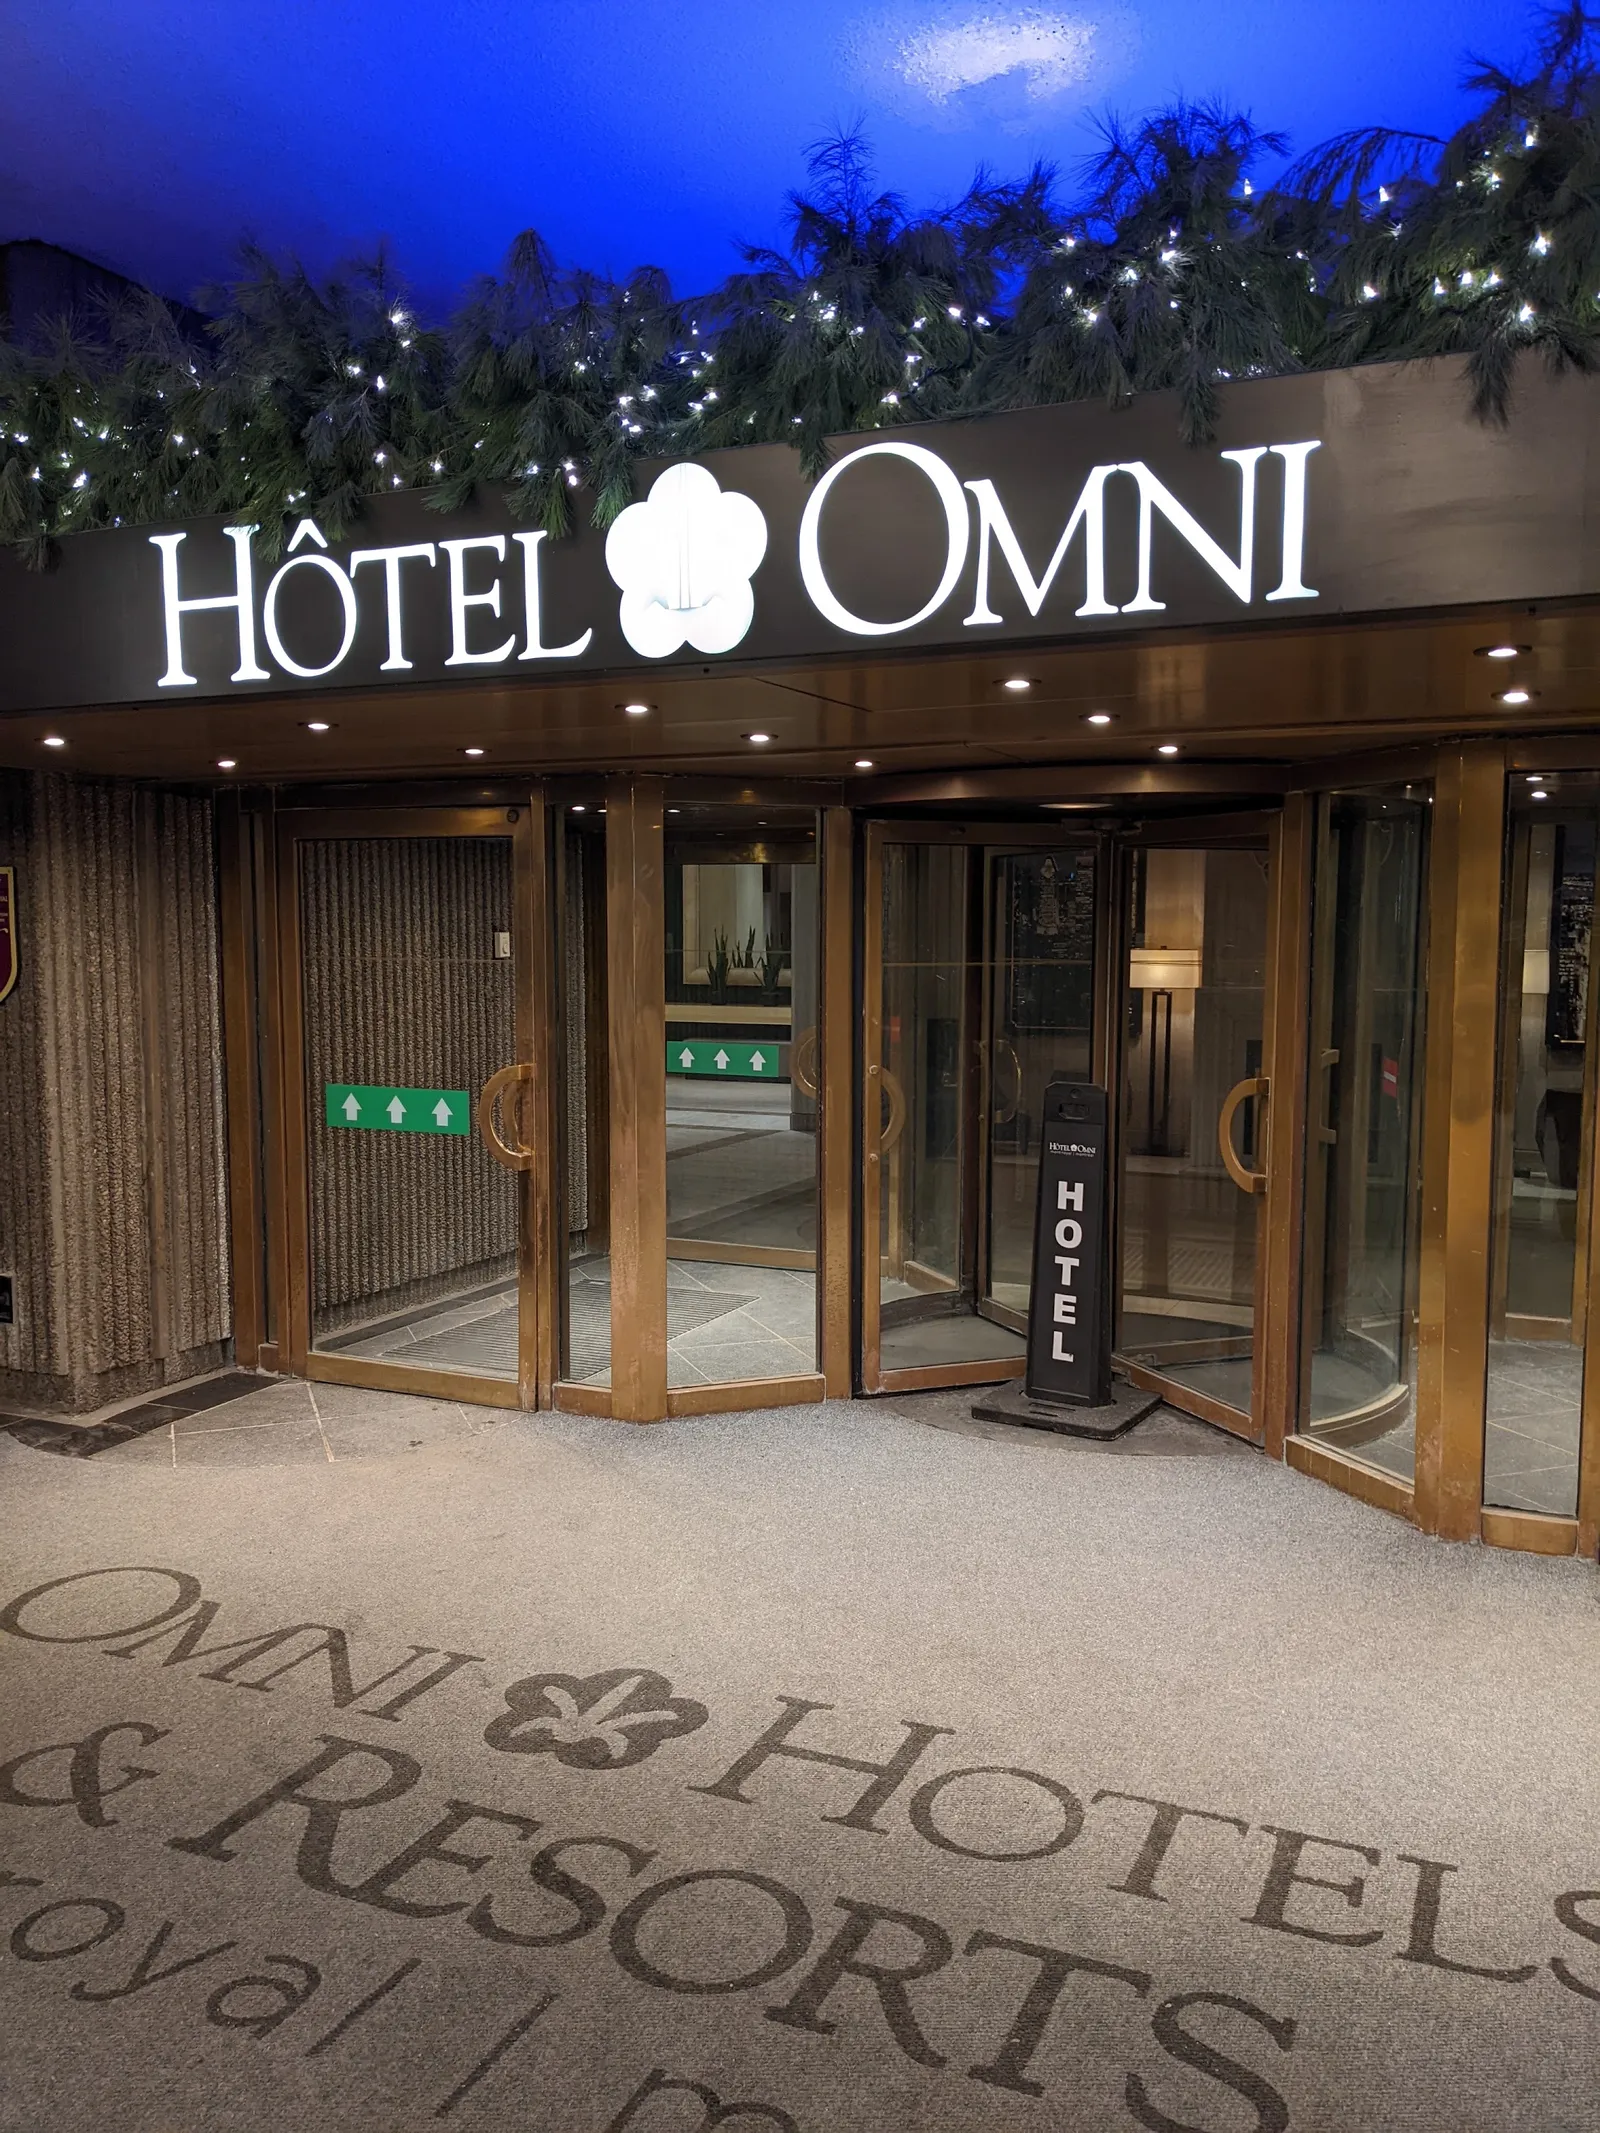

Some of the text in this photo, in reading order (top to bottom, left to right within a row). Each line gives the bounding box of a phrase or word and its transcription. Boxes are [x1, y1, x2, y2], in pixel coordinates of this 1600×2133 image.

[148, 441, 1322, 687] HÔTEL OMNI
[1051, 1180, 1085, 1363] HOTEL
[0, 1566, 486, 1723] OMNI
[0, 1721, 1299, 2133] & RESORTS
